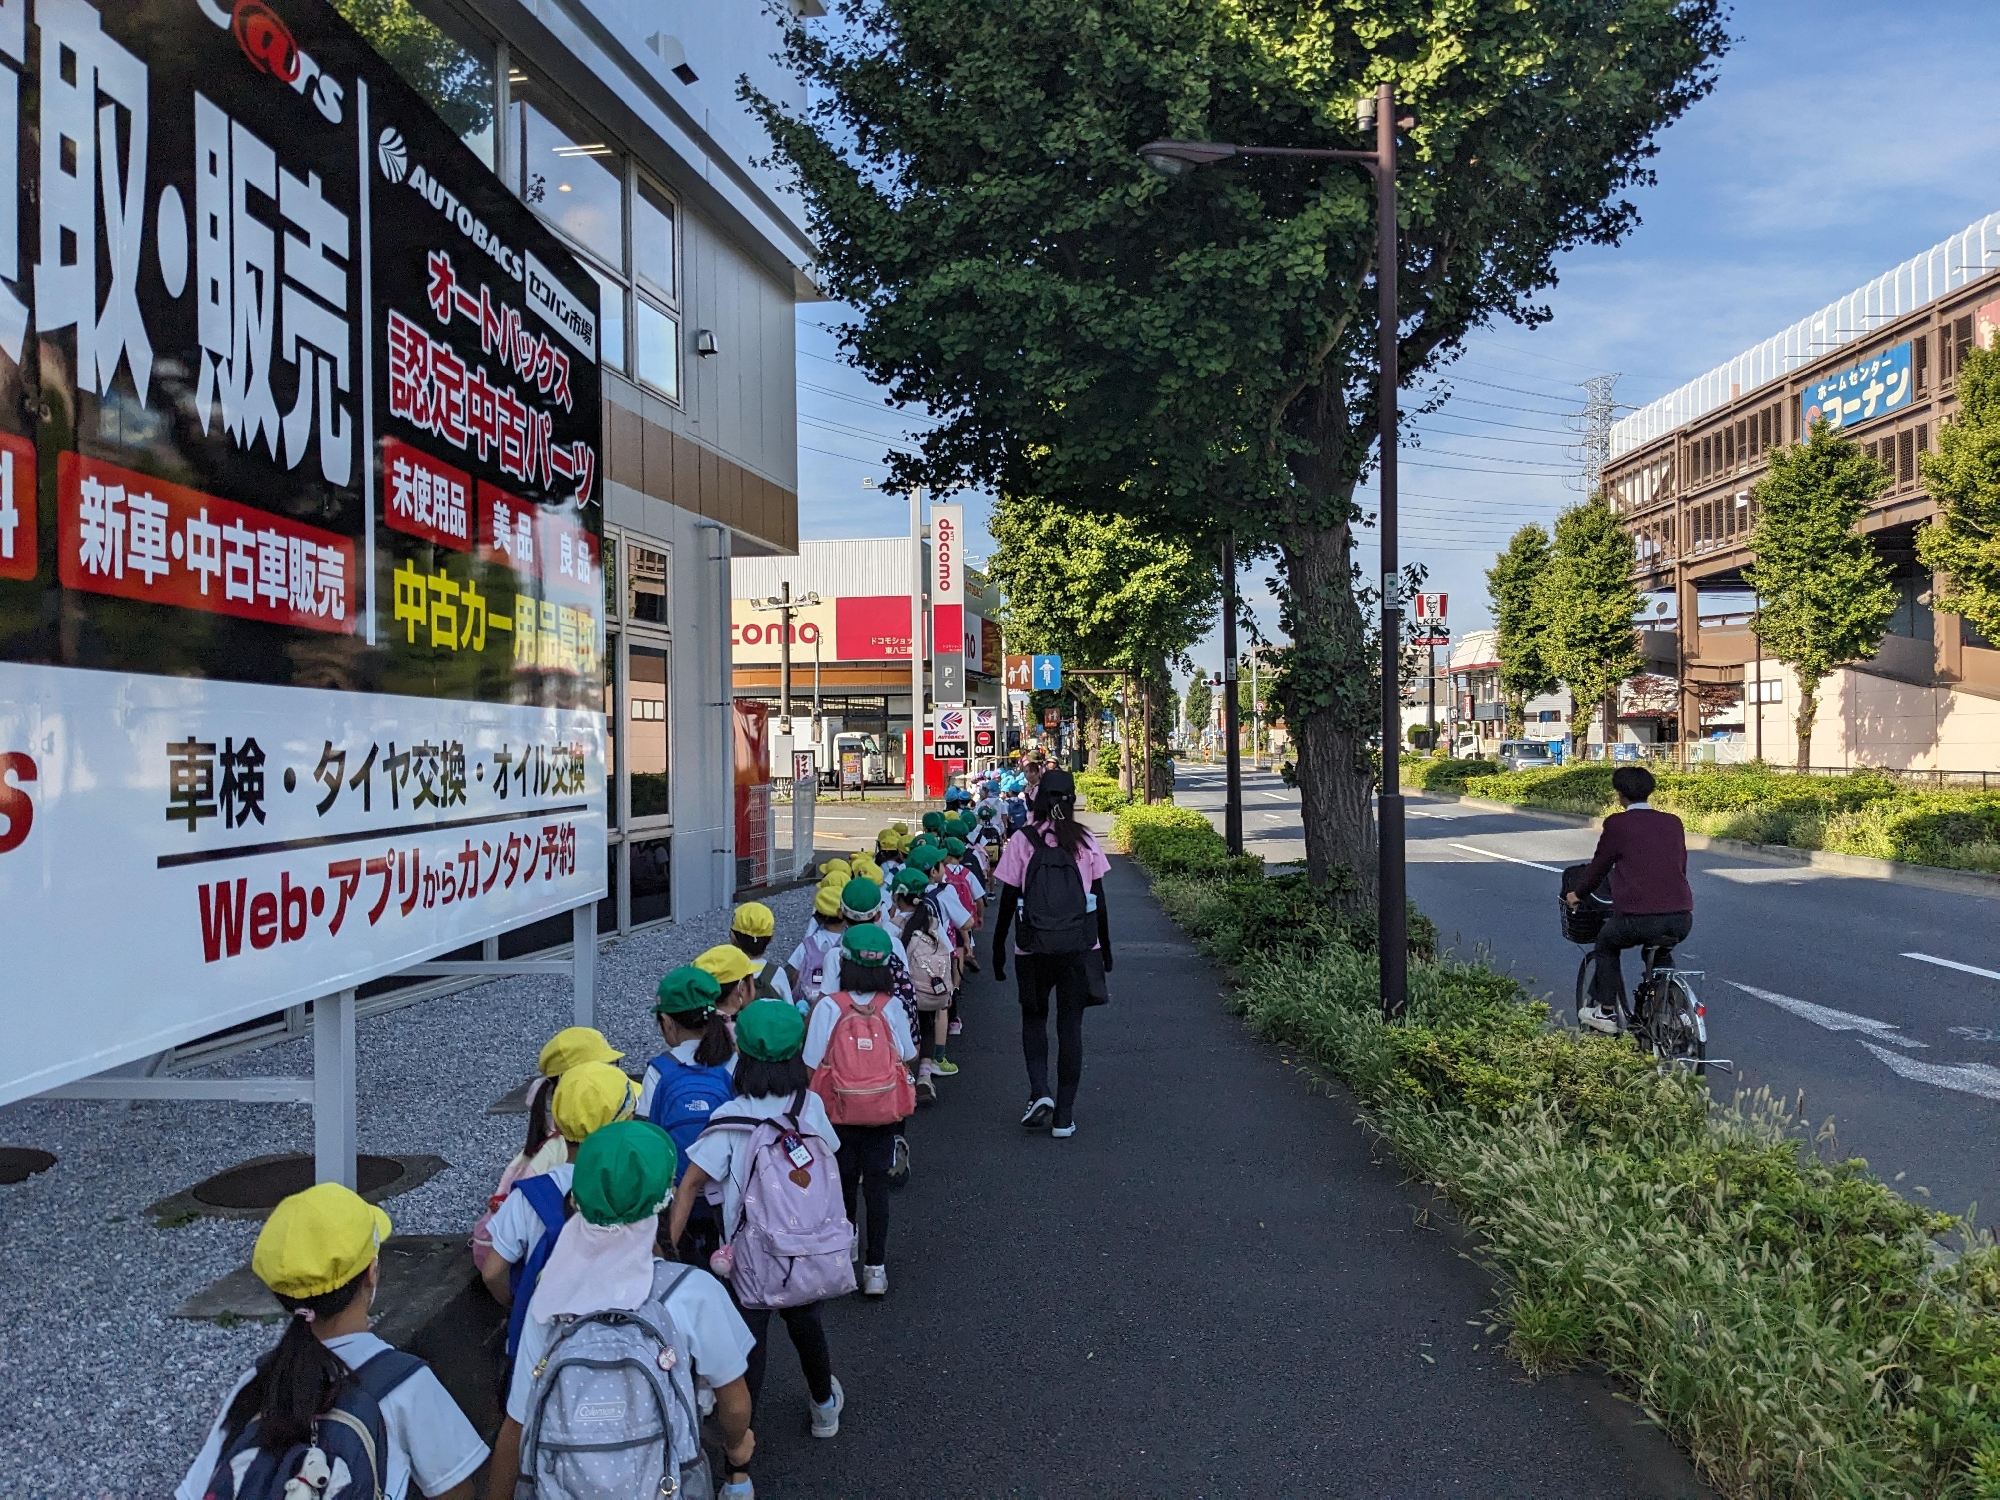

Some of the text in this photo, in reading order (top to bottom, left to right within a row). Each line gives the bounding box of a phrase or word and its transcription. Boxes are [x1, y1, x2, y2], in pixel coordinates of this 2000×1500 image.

[0, 0, 353, 488] 取・販売
[407, 164, 524, 283] AUTOBACS
[427, 250, 573, 413] オートバックス
[528, 271, 592, 348] セコハン市場
[388, 308, 595, 510] 認定中古パーツ
[1817, 359, 1892, 400] ホームセンター
[1822, 367, 1909, 431] コーナン
[392, 456, 467, 540] 未使用品
[78, 476, 345, 621] 新車・中古車販売
[938, 518, 951, 592] docomo
[393, 558, 596, 674] 中古カー用品買取
[1422, 617, 1442, 625] KFC
[800, 754, 809, 776] タイヤ
[937, 744, 956, 757] IN
[975, 745, 994, 754] OUT
